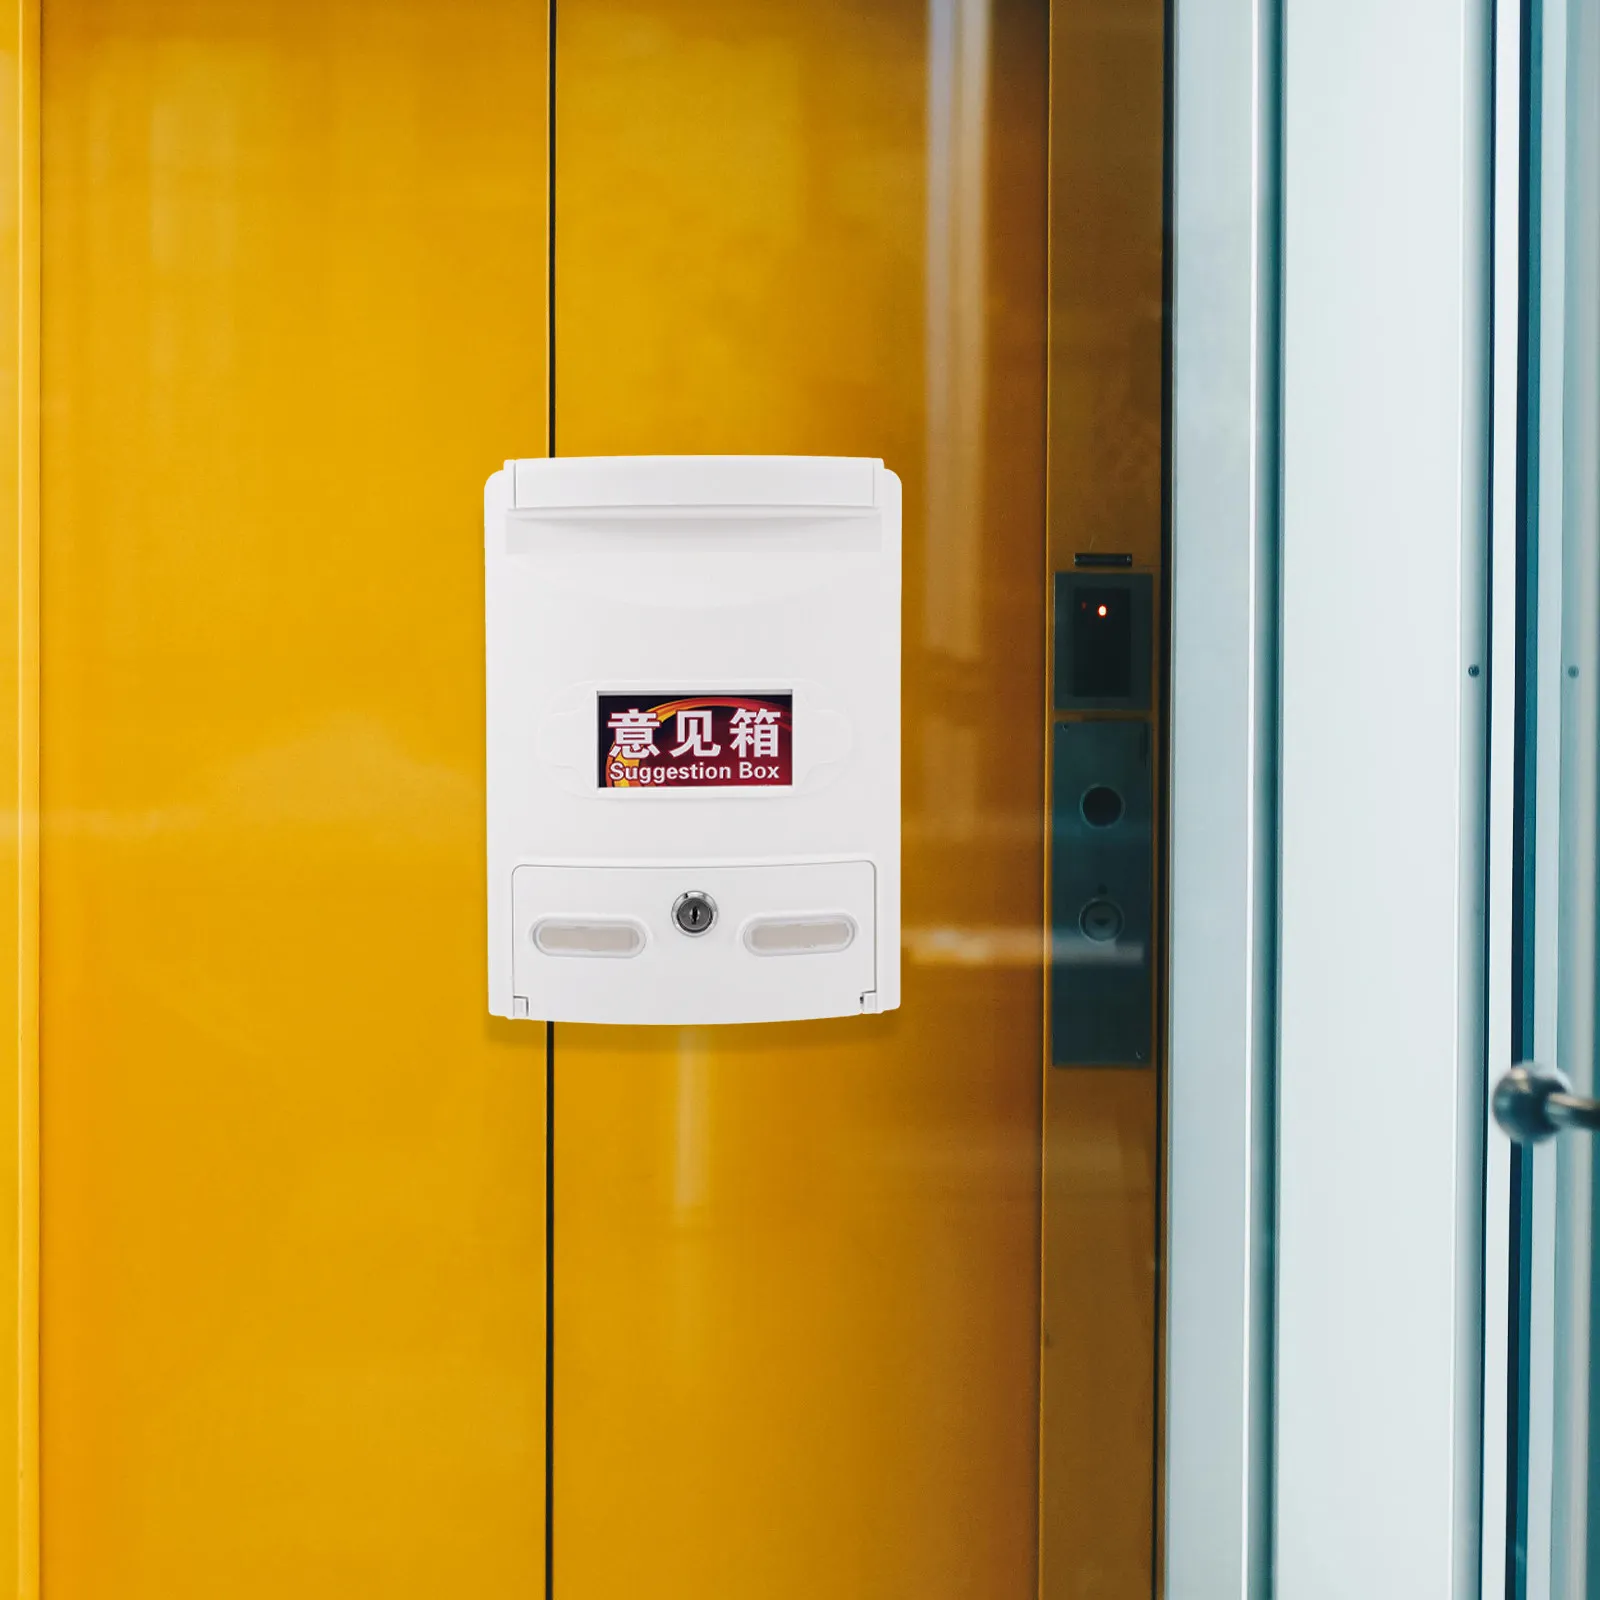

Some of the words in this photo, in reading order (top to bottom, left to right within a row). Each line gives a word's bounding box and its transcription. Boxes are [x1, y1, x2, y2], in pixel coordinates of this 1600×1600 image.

[607, 708, 781, 758] 意见箱
[609, 762, 731, 784] Suggestion
[739, 761, 780, 780] Box
